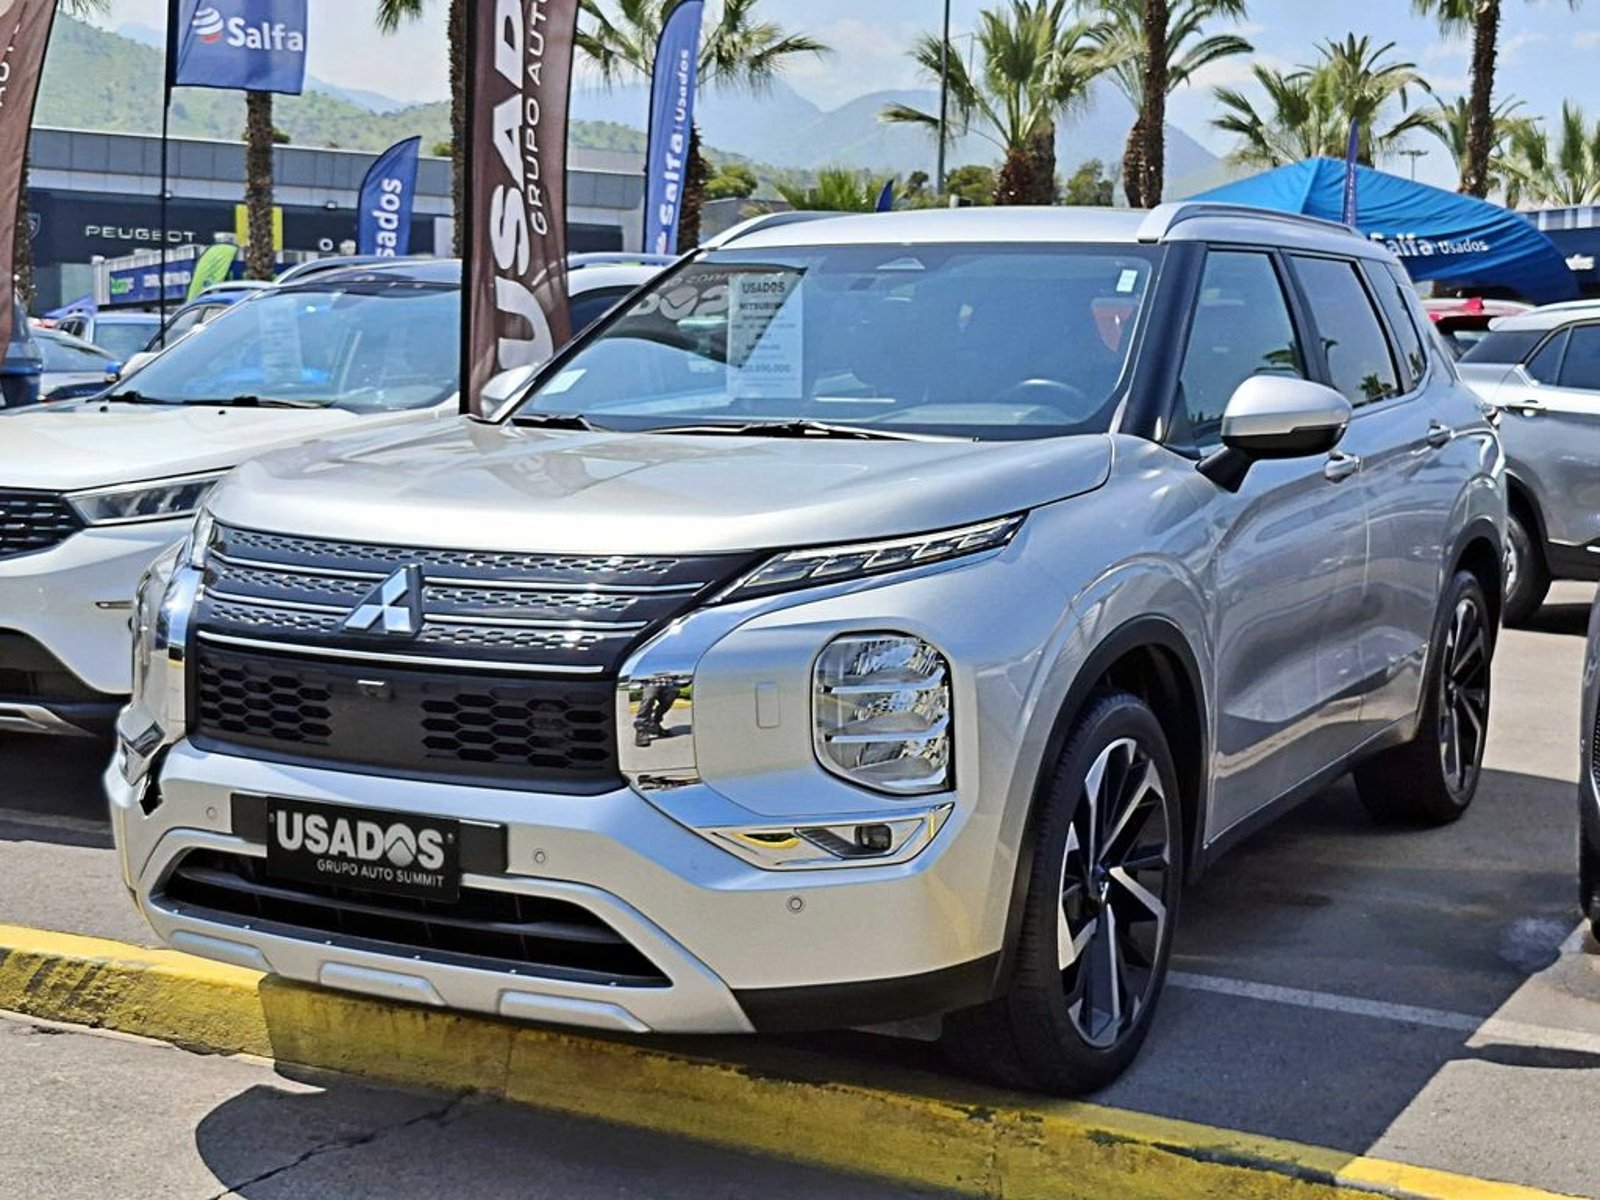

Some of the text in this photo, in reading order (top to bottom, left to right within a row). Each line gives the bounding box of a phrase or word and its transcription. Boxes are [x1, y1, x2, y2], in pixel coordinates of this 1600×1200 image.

[227, 16, 304, 51] Salfa
[525, 0, 549, 236] GRUPO AUT
[659, 49, 690, 227] Salfa Usados
[85, 225, 196, 242] PEUGEOT
[1438, 238, 1489, 254] Usados
[742, 281, 786, 295] USADOS
[276, 811, 444, 870] USADOS
[317, 858, 444, 888] GRUPO AUTO SUMMIT
